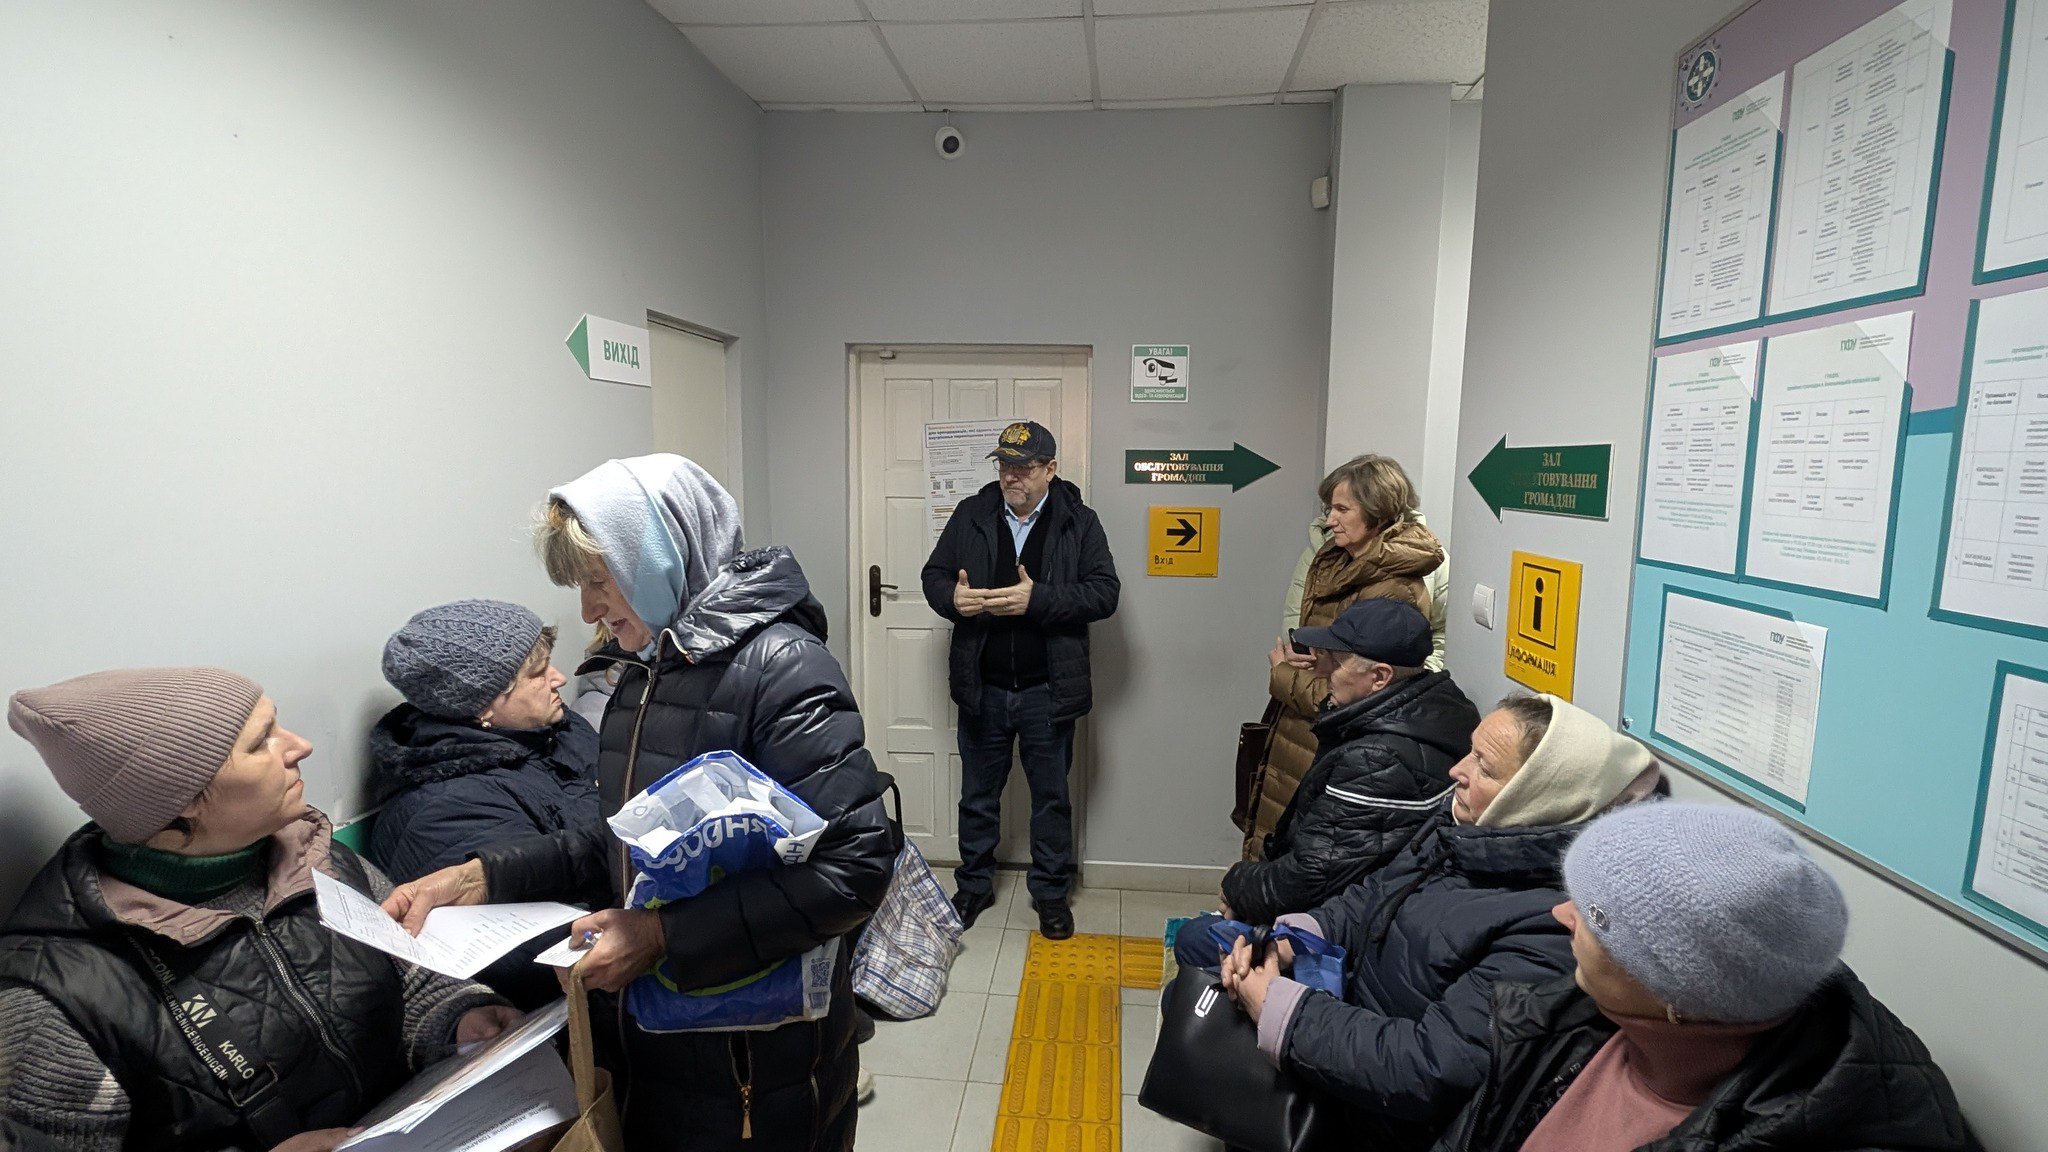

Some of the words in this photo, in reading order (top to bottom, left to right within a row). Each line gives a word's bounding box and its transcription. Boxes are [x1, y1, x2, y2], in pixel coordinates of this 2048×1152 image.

[603, 339, 640, 369] ВИХІД
[1149, 347, 1173, 356] УВАГА!
[1169, 452, 1189, 461] ЗАЛ
[1542, 452, 1562, 467] ЗАЛ
[1134, 462, 1224, 472] ОБСЛУГОВУВАННЯ
[1151, 472, 1206, 483] ГРОМАДЯН
[1523, 491, 1577, 510] ГРОМАДЯН
[1154, 554, 1174, 565] Вхід
[1770, 631, 1786, 645] ПФУ
[218, 1039, 255, 1080] KARLO
